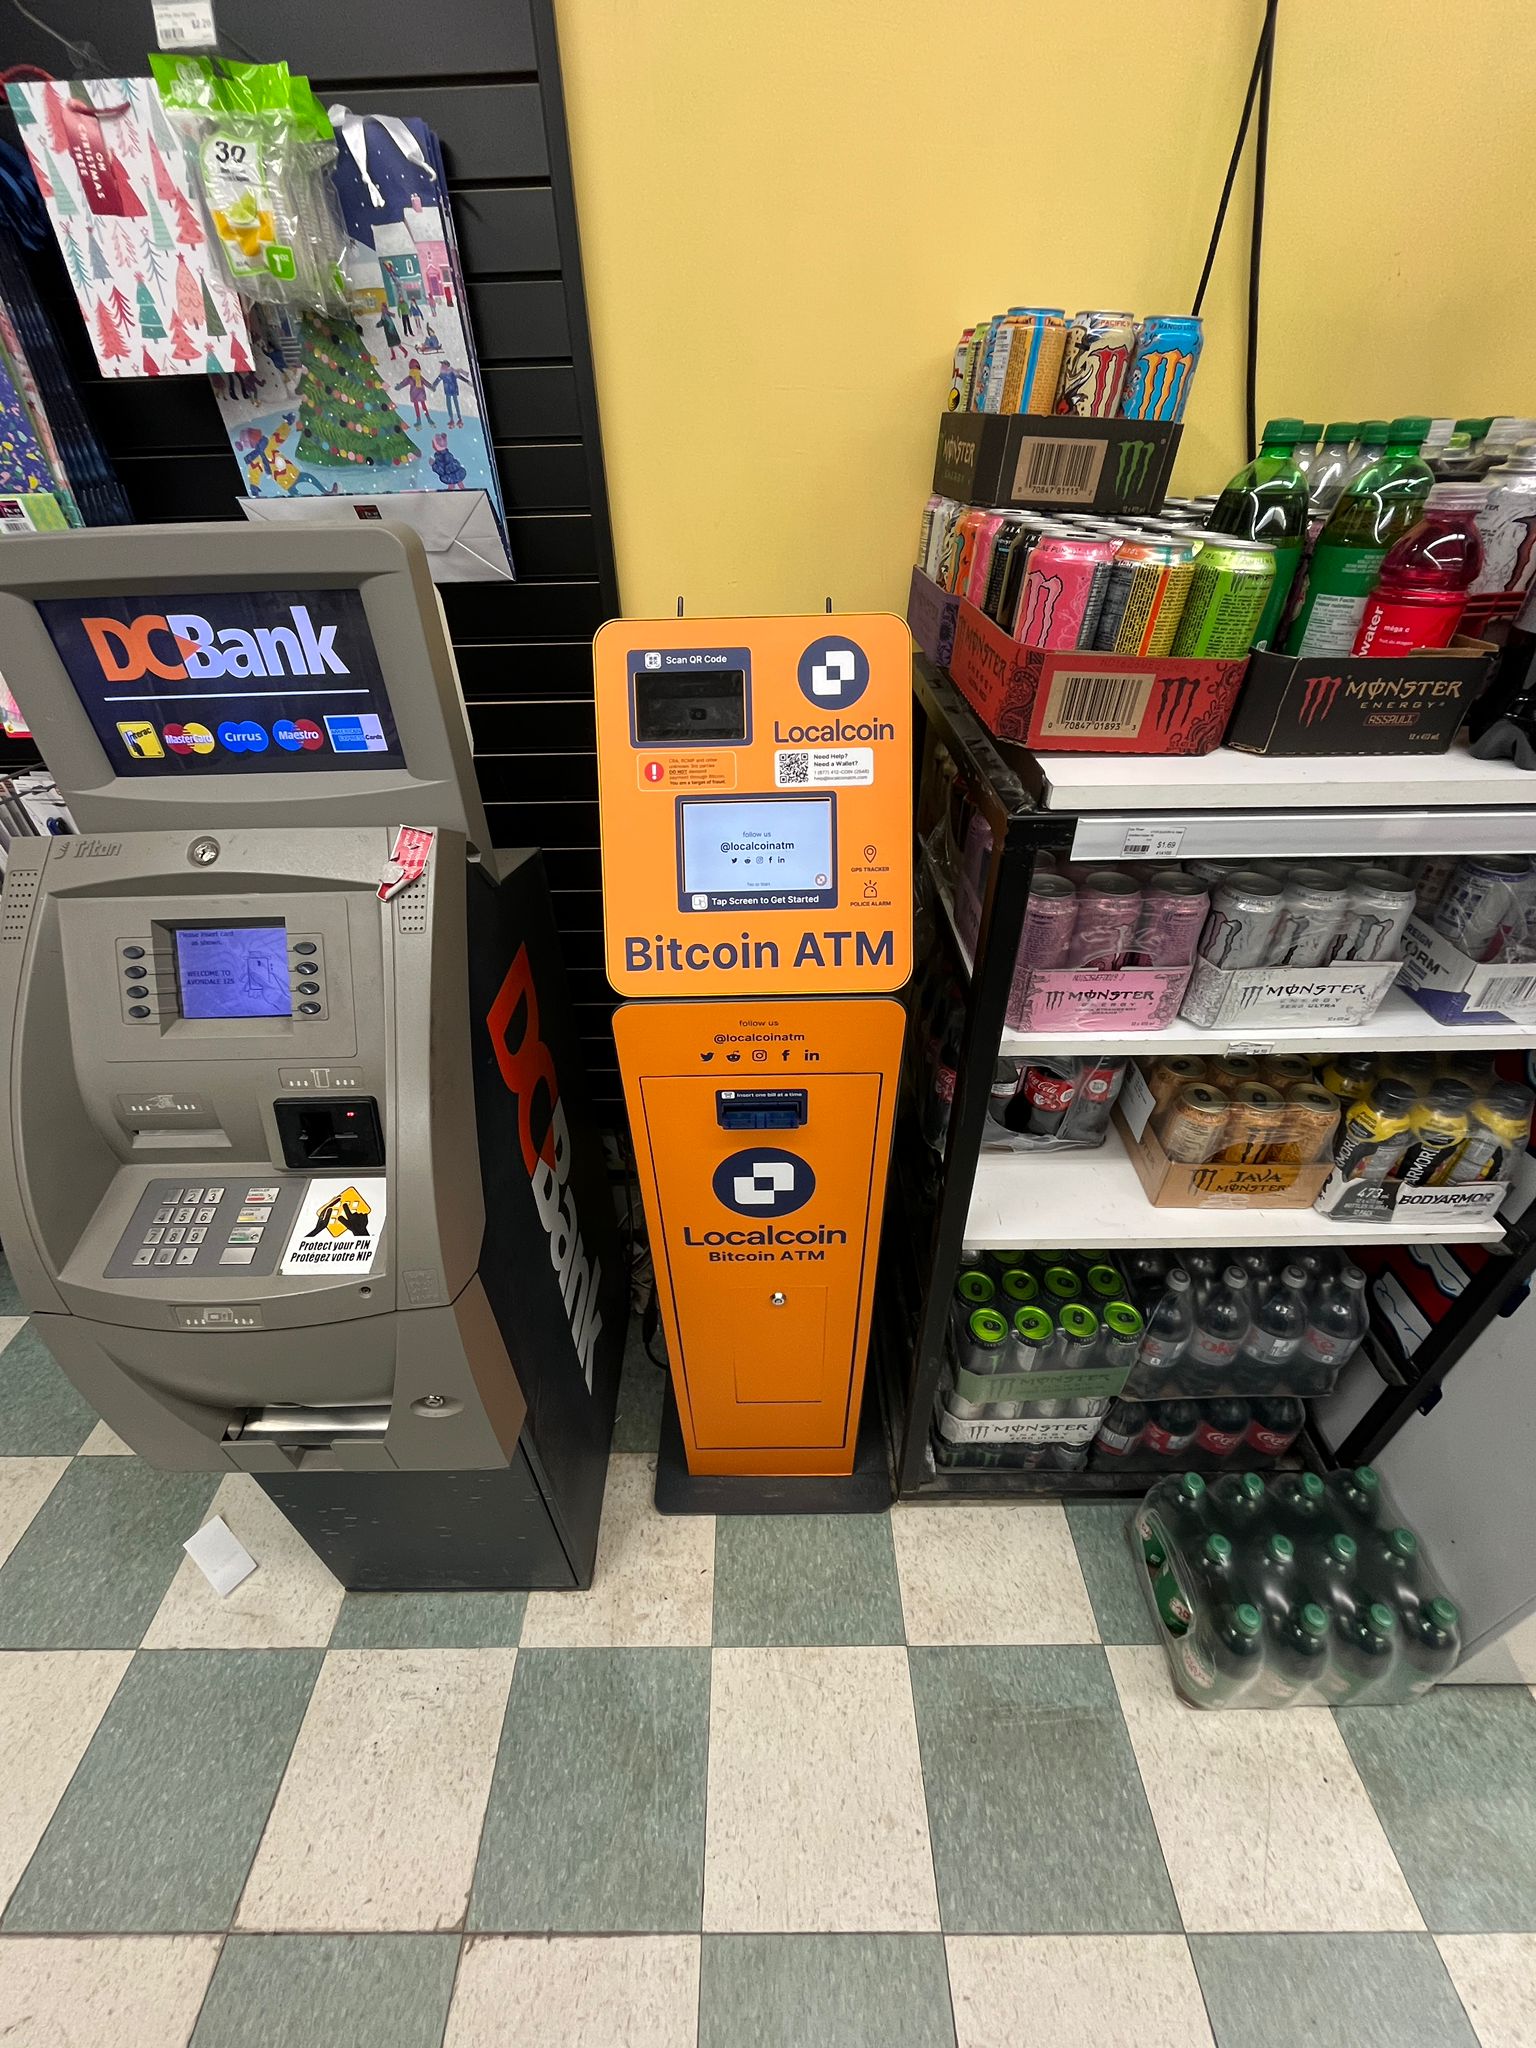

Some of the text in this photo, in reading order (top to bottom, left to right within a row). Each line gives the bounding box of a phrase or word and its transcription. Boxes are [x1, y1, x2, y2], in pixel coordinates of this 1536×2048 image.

[215, 141, 246, 164] 30
[73, 145, 89, 176] TREE
[1031, 486, 1054, 494] 70847
[1358, 605, 1384, 656] water
[80, 605, 351, 682] DCBank
[665, 654, 728, 665] Scan QR Code
[1360, 701, 1438, 709] ENERGY
[774, 717, 895, 743] Localcoin
[1064, 721, 1091, 730] 70847
[1093, 722, 1121, 731] 01893
[165, 734, 213, 745] MasterCard
[224, 732, 262, 742] Cirrus
[278, 730, 319, 740] Maestro
[742, 830, 762, 839] follow
[720, 841, 795, 854] @localcoinatm
[1157, 841, 1176, 849] $1.69
[711, 895, 819, 907] Tap Screen to Get Started
[625, 930, 894, 972] Bitcoin ATM
[739, 1020, 766, 1028] follow
[713, 1033, 805, 1045] @localcoinatm
[486, 940, 603, 1396] DCBank
[1230, 1169, 1282, 1183] JAVA
[208, 1193, 216, 1202] 3
[1356, 1187, 1383, 1199] 473
[1399, 1192, 1495, 1205] BODYARMOR
[179, 1212, 187, 1221] 5
[200, 1212, 208, 1221] 6
[169, 1232, 178, 1241] 8
[191, 1232, 199, 1241] 9
[683, 1225, 847, 1247] Localcoin
[298, 1240, 371, 1251] Protect your PIN
[290, 1251, 372, 1263] Protégez votre NIP
[709, 1250, 825, 1262] Bitcoin ATM
